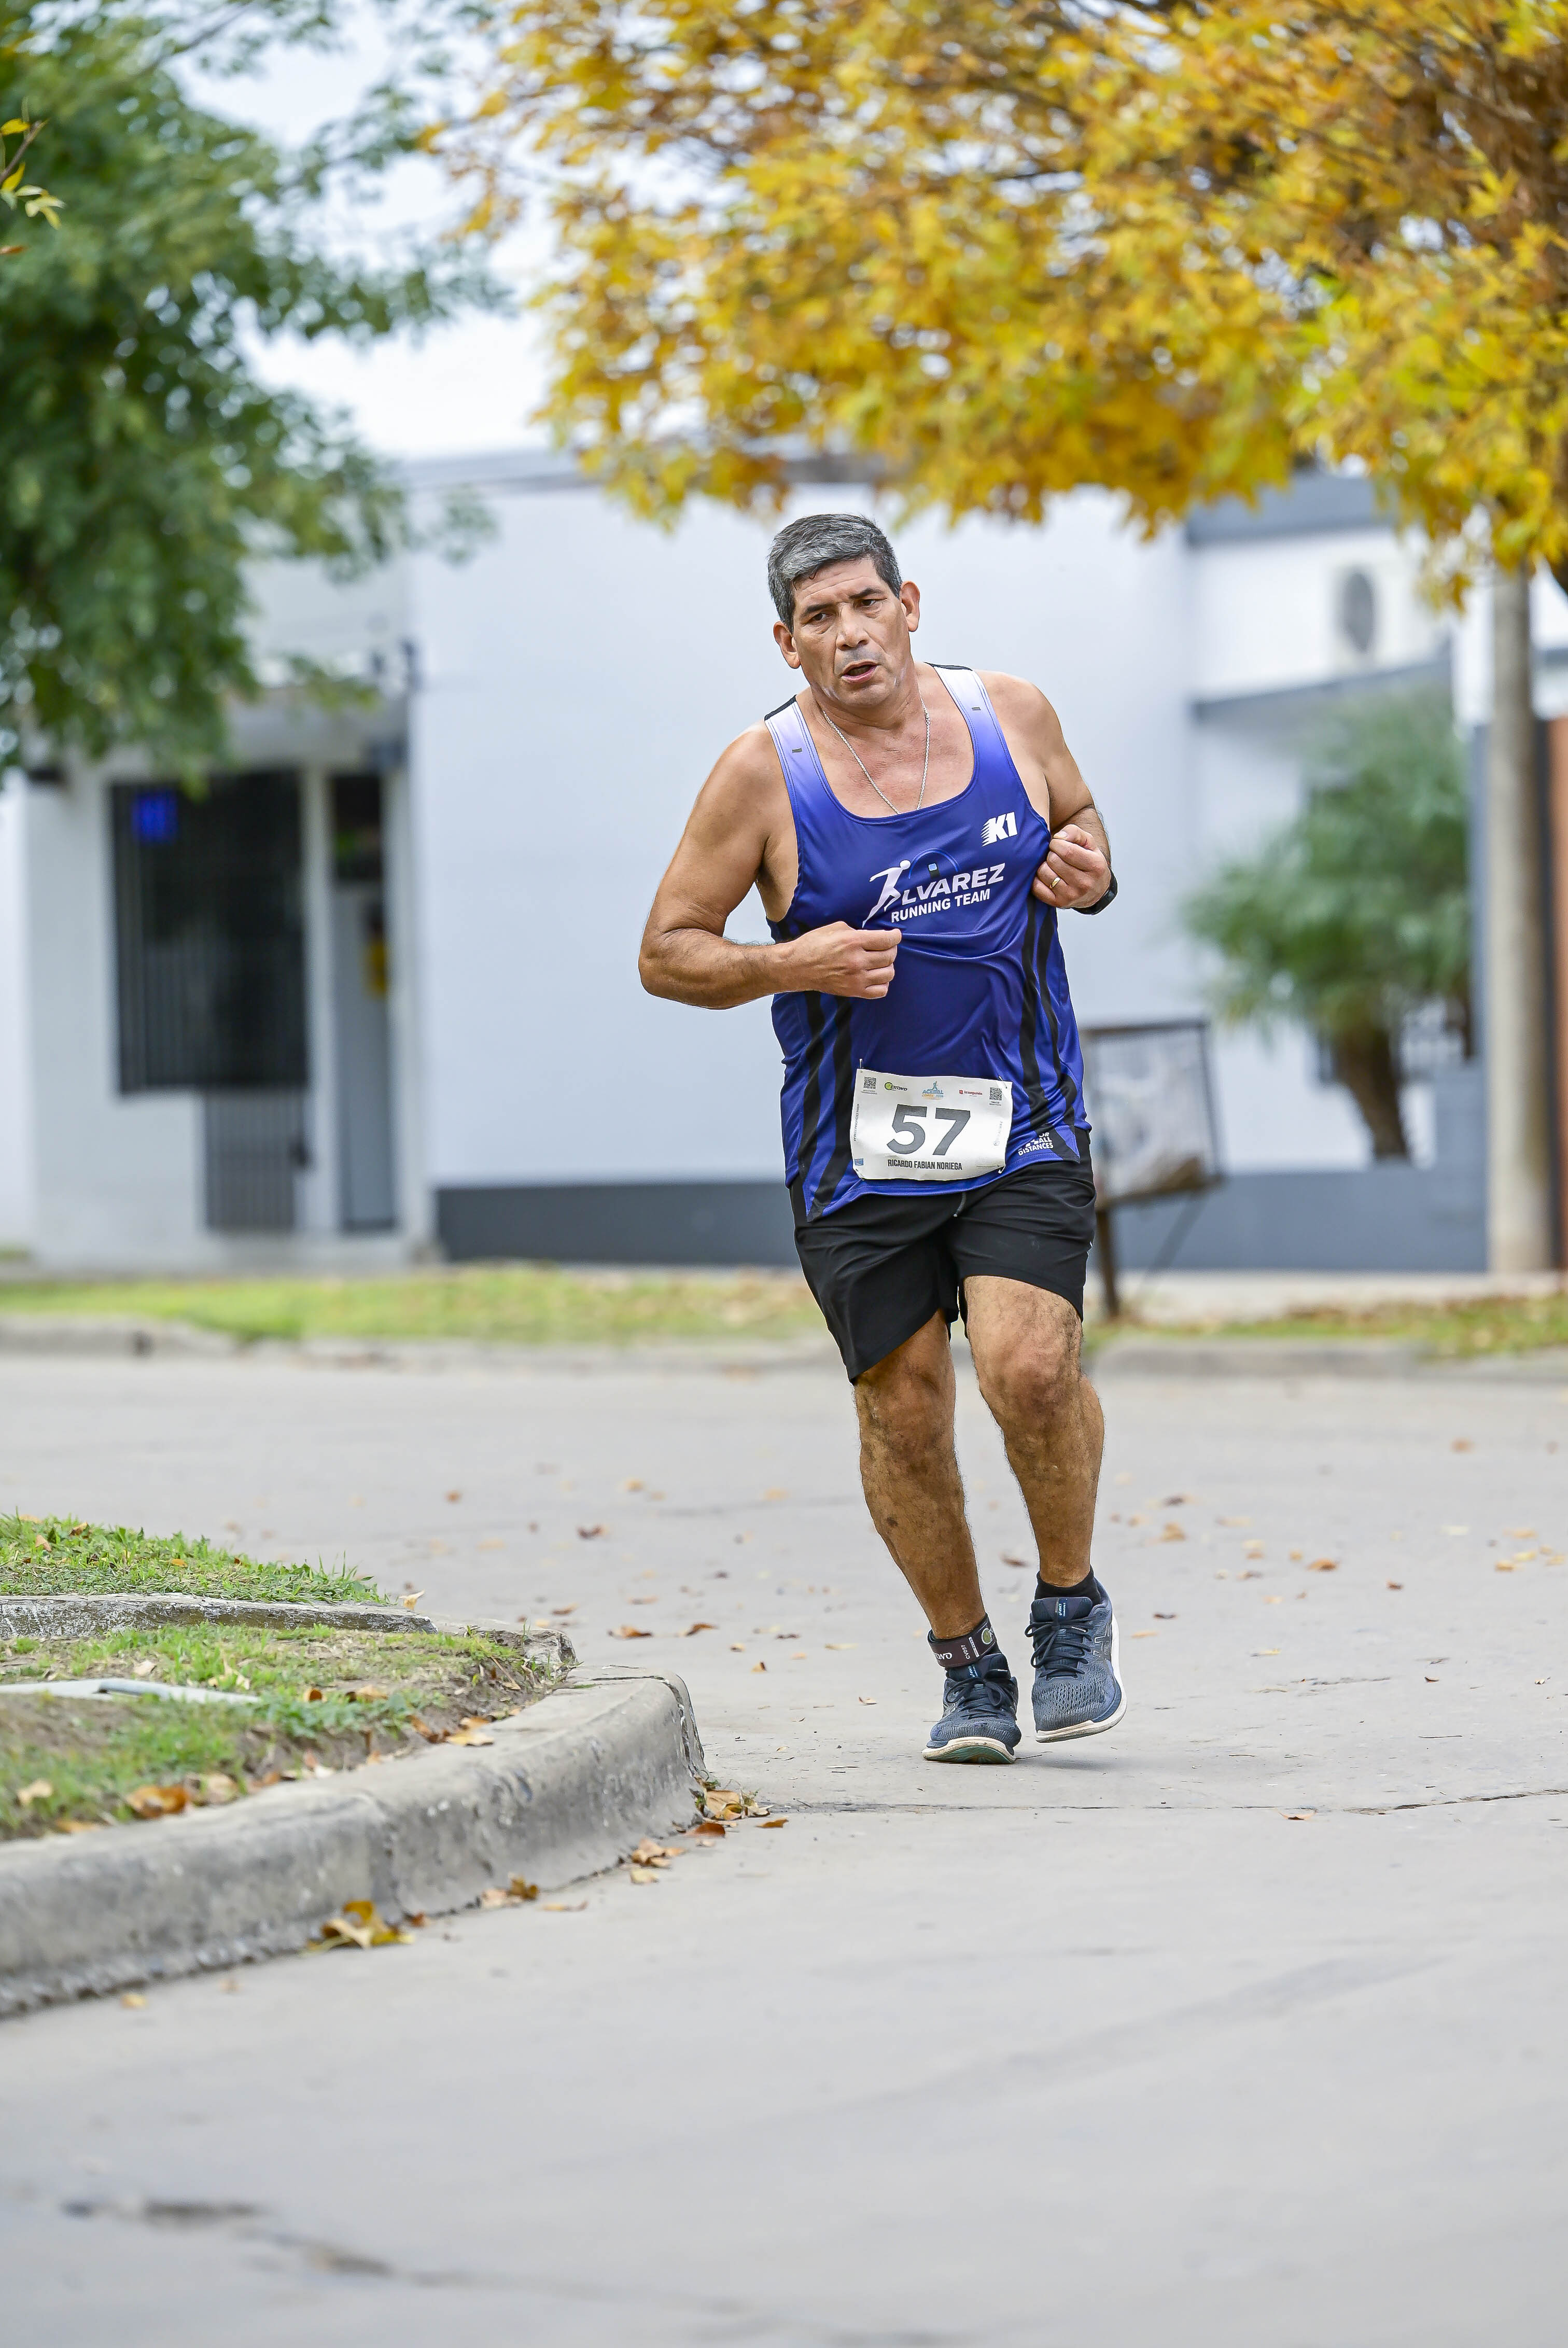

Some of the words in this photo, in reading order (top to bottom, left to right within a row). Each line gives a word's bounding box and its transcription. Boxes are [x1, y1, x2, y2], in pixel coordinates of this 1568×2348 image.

[891, 898, 951, 923] RUNNING
[954, 888, 990, 907] TEAM
[887, 1103, 971, 1156] 57
[1018, 1142, 1054, 1156] DISTANCES
[888, 1159, 912, 1168] RICARDO
[914, 1161, 935, 1169] FABIAN
[936, 1162, 963, 1170] NORIEGA
[961, 1645, 971, 1659] CV057
